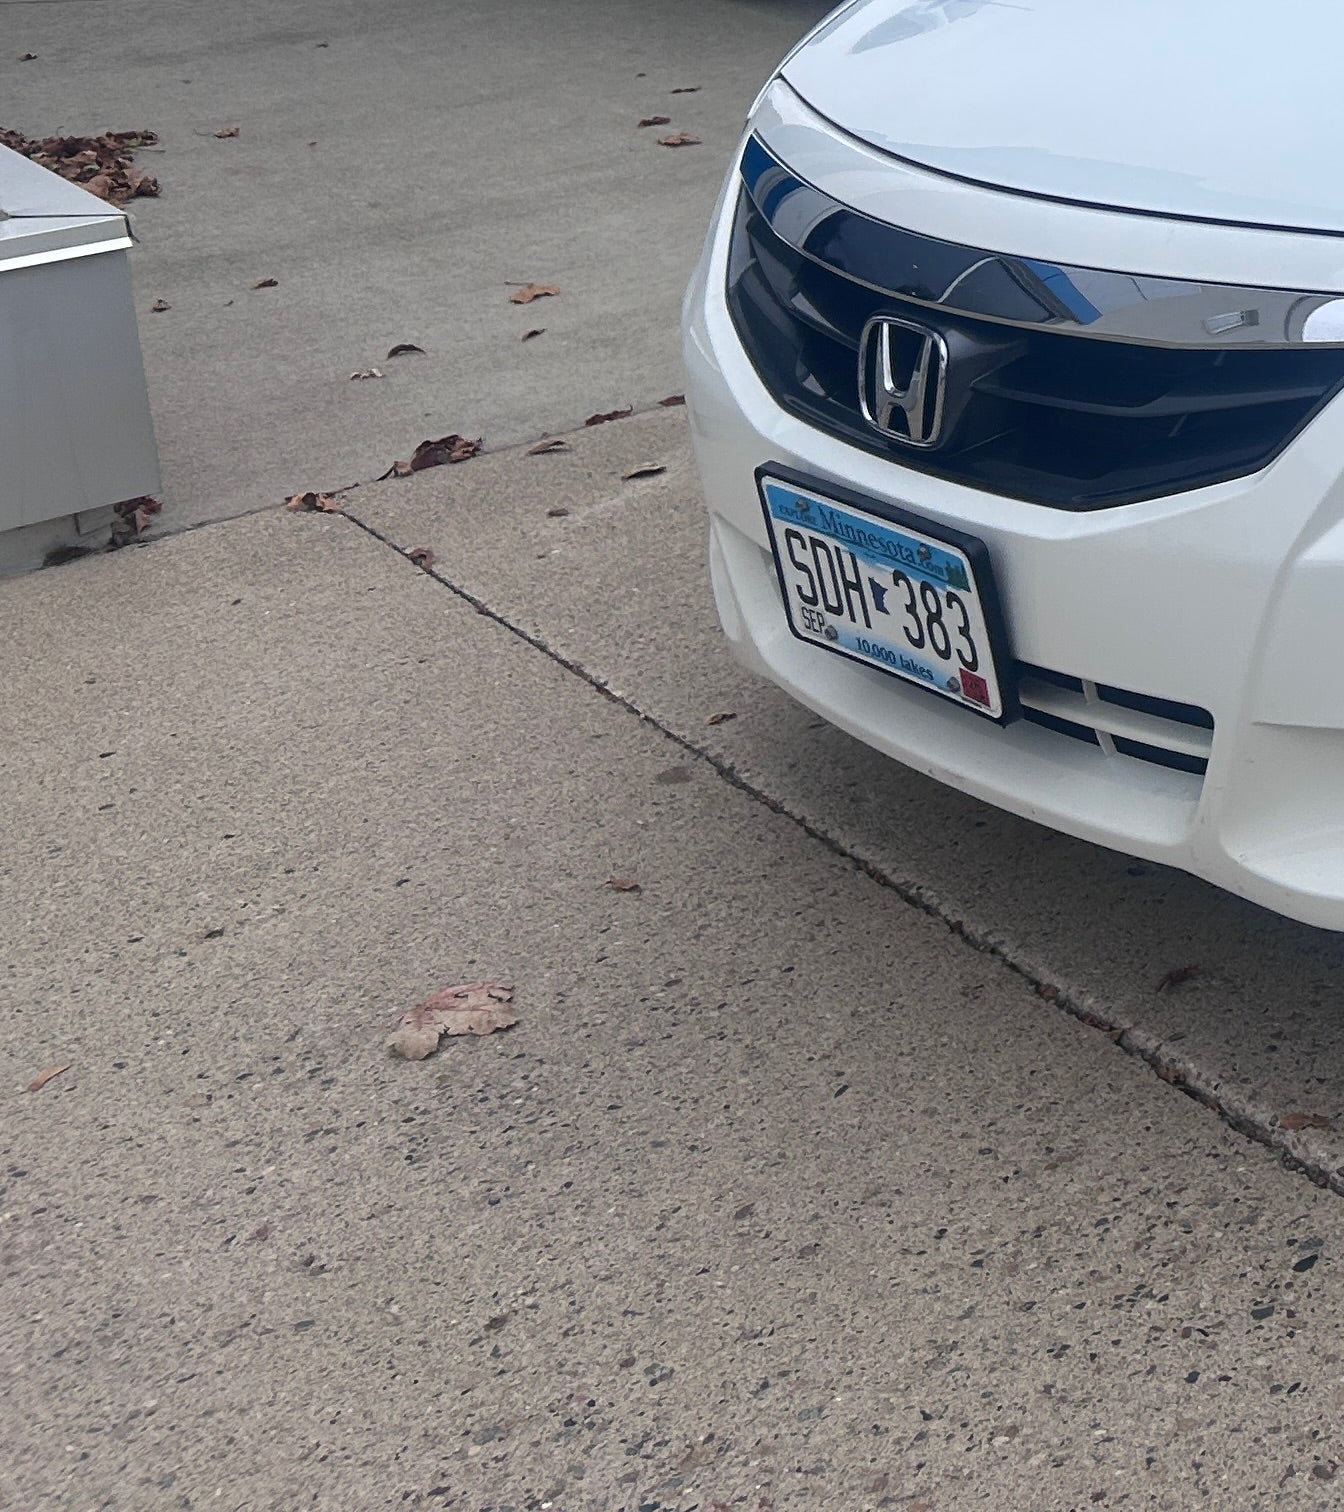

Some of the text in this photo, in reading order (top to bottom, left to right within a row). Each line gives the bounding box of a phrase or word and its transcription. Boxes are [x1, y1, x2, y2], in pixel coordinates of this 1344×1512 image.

[784, 527, 979, 672] SDH 383
[801, 606, 825, 633] SEP
[900, 655, 934, 680] lakes
